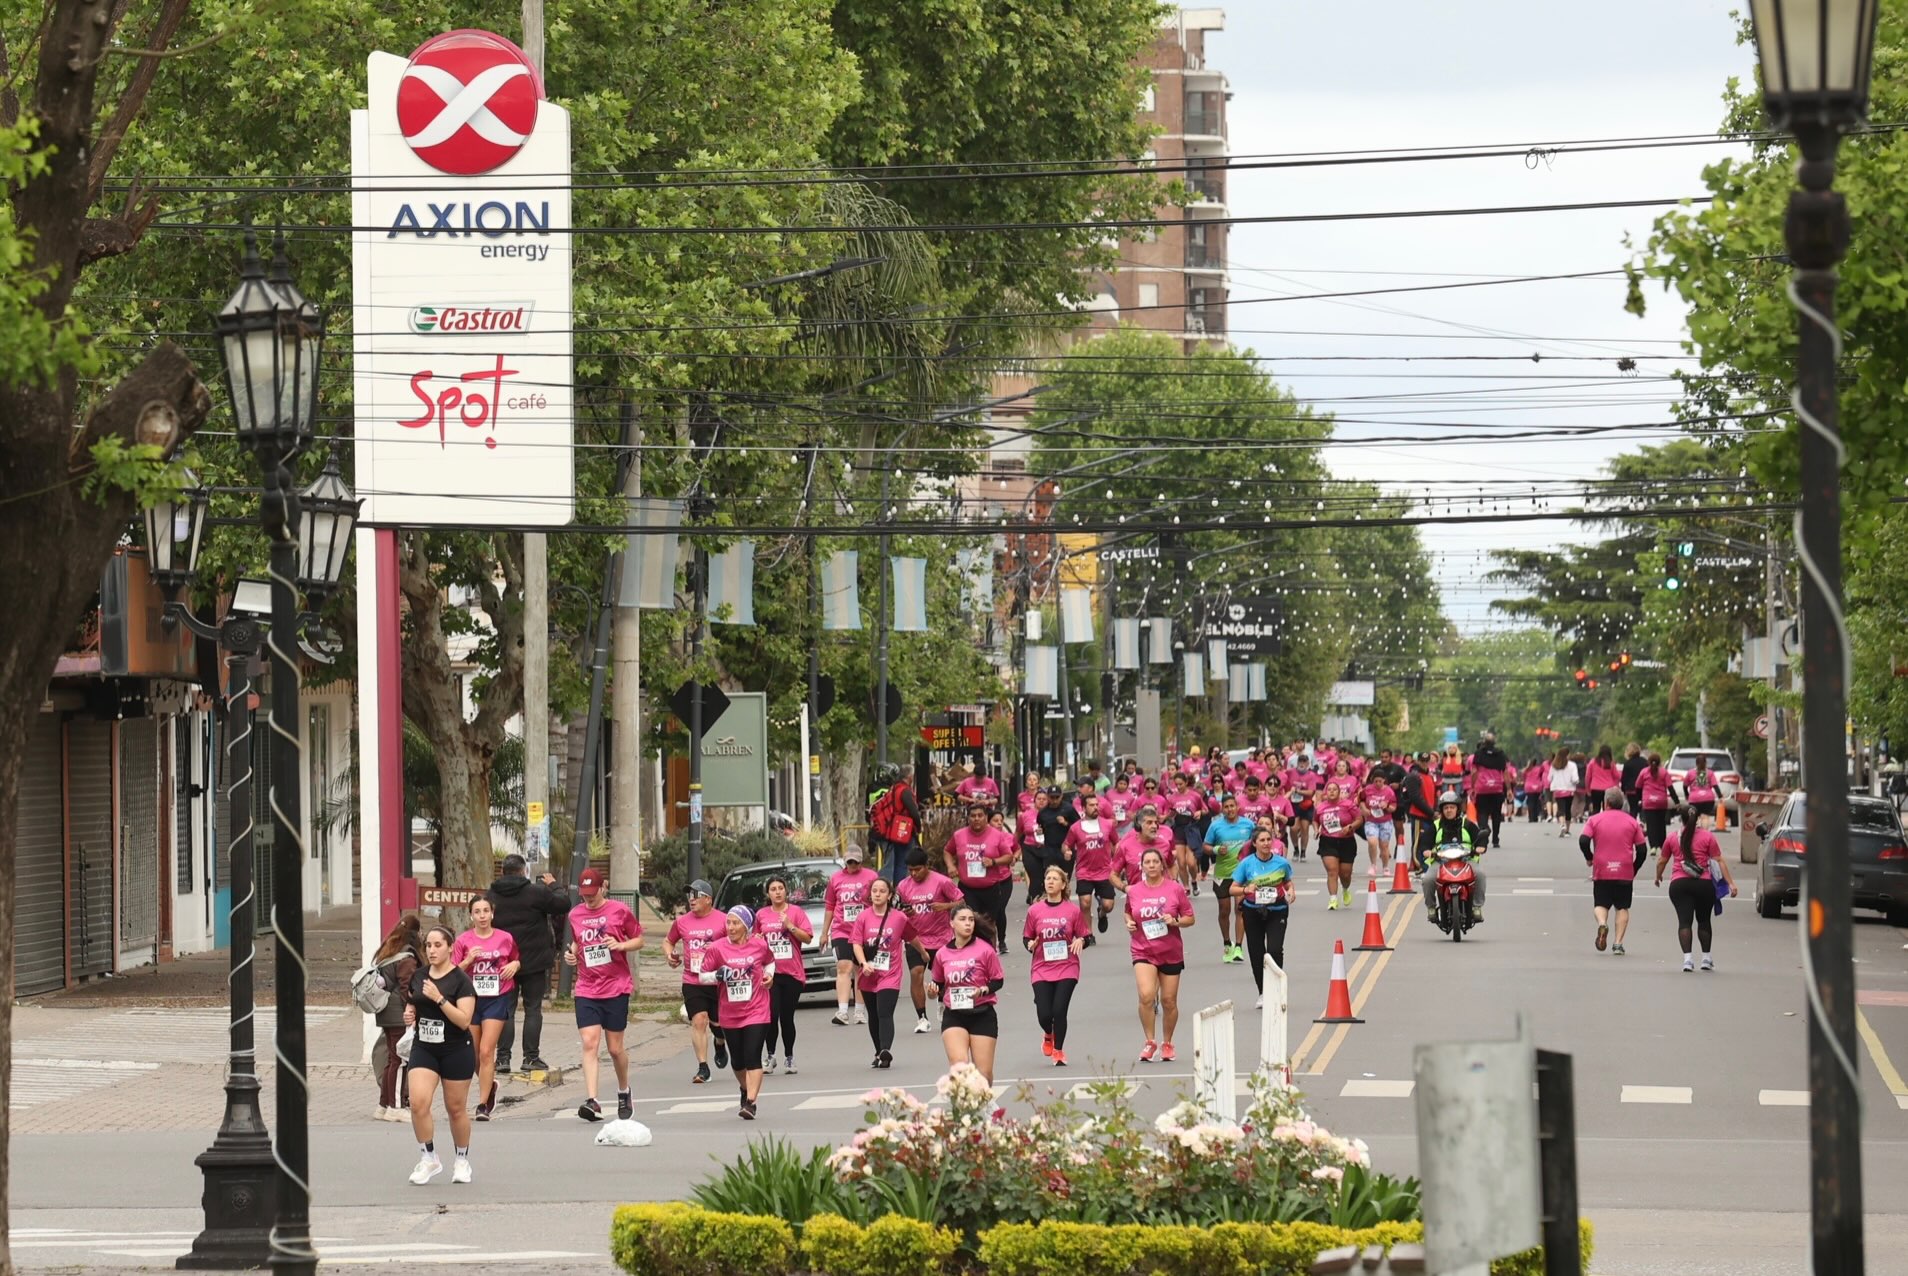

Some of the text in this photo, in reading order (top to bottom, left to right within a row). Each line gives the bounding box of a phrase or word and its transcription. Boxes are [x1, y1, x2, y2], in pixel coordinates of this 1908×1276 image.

[387, 201, 549, 239] AXION
[481, 244, 549, 262] energy
[440, 307, 523, 331] Castrol
[507, 393, 547, 410] café
[1101, 547, 1160, 561] CASTELLI
[1222, 623, 1273, 637] NOBLE
[1140, 906, 1163, 918] 10K
[580, 929, 604, 943] 10K
[1041, 927, 1065, 939] 10K
[588, 950, 606, 960] 3268
[772, 945, 788, 953] 3313
[473, 961, 495, 974] 10K
[947, 971, 971, 984] 10K
[477, 981, 495, 990] 3269
[730, 986, 747, 995] 3181
